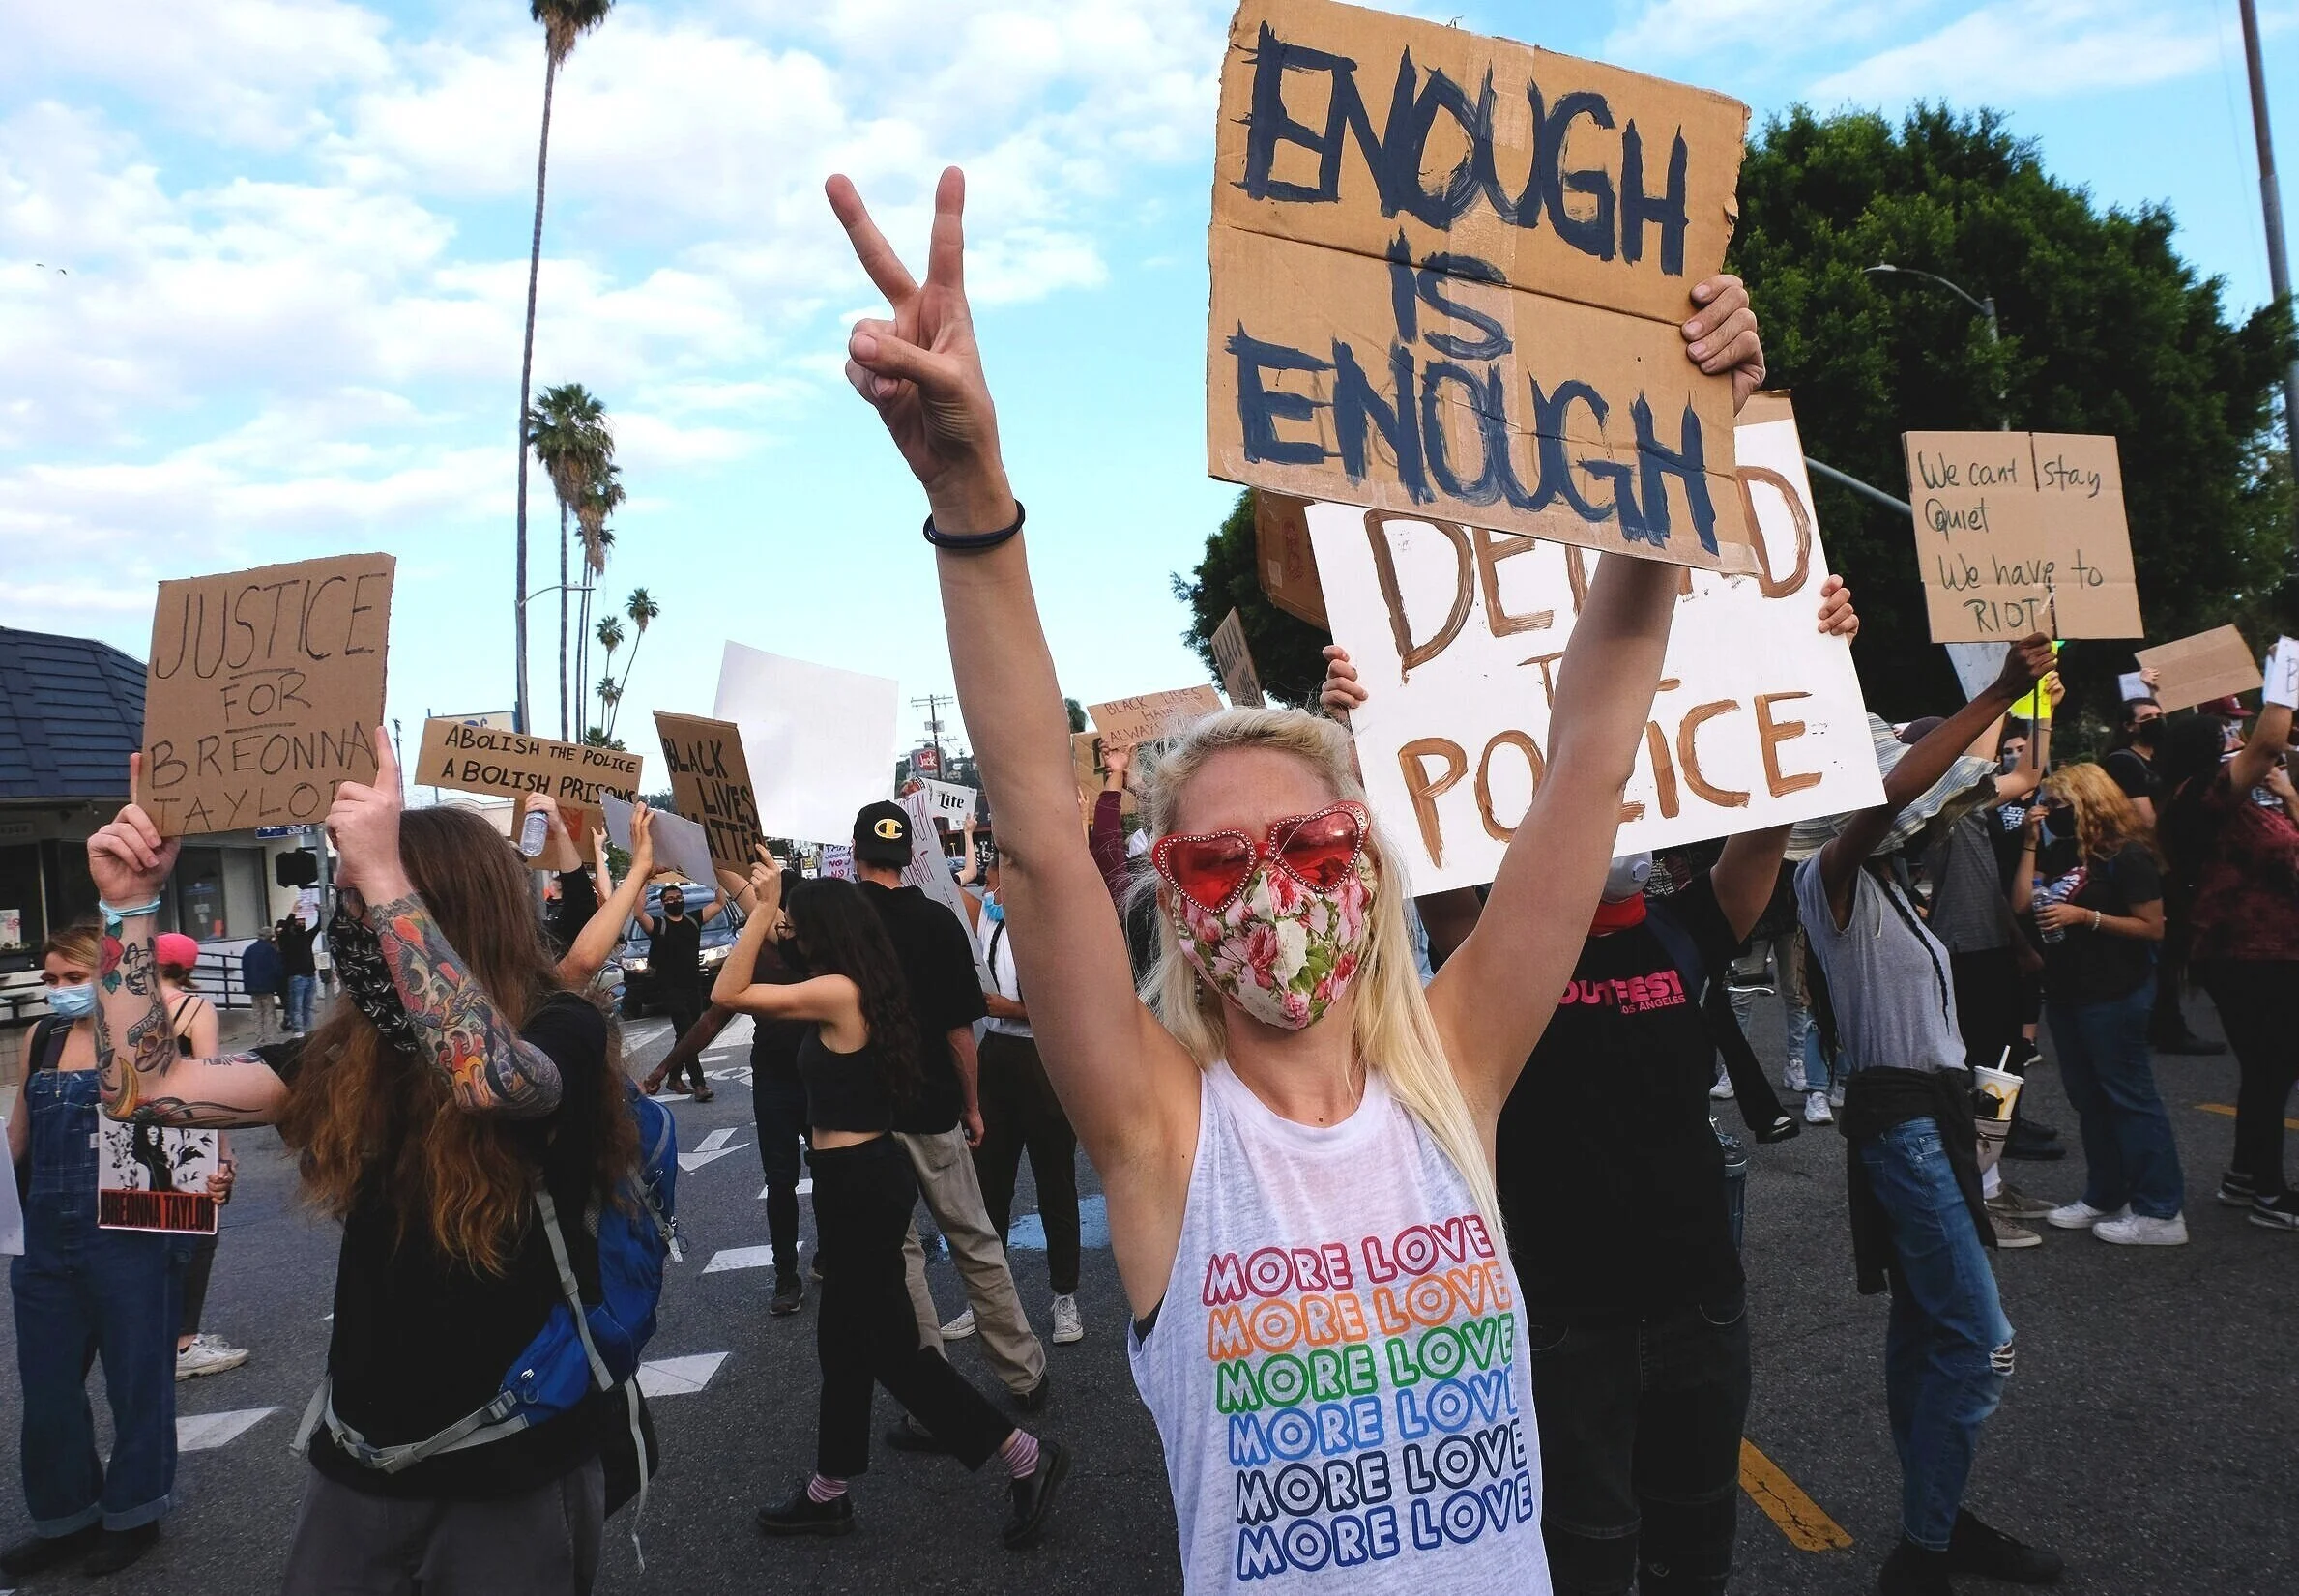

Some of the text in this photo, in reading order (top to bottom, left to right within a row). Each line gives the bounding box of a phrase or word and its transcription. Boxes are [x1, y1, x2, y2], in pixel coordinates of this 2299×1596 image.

[1229, 20, 1689, 277] ENOUGH
[1387, 227, 1513, 360] IS
[1226, 319, 1720, 557] ENOUGH
[1918, 450, 2101, 499] We cant stay
[1925, 497, 1991, 544] Quiet
[1938, 549, 2104, 592] We have to
[155, 572, 387, 680] JUSTICE
[1963, 597, 2041, 633] RIOT
[220, 672, 312, 723] FOR
[1104, 695, 1149, 716] BLACK
[150, 721, 379, 790] BREONNA
[441, 758, 550, 796] ABOLISH
[444, 724, 637, 774] ABOLISH THE POLICE
[661, 738, 729, 779] BLACK
[695, 777, 758, 831] LIVES
[939, 793, 965, 810] Lite
[1398, 692, 1823, 868] POICE
[1639, 994, 1686, 1012] ANGELES
[1203, 1214, 1496, 1307] MORE LOVE
[1207, 1260, 1513, 1362] MORE LOVE
[1215, 1312, 1515, 1415] MORE LOVE
[1228, 1395, 1385, 1469] MORE
[1236, 1417, 1528, 1526] MORE LOVE
[1236, 1469, 1534, 1582] MORE LOVE
